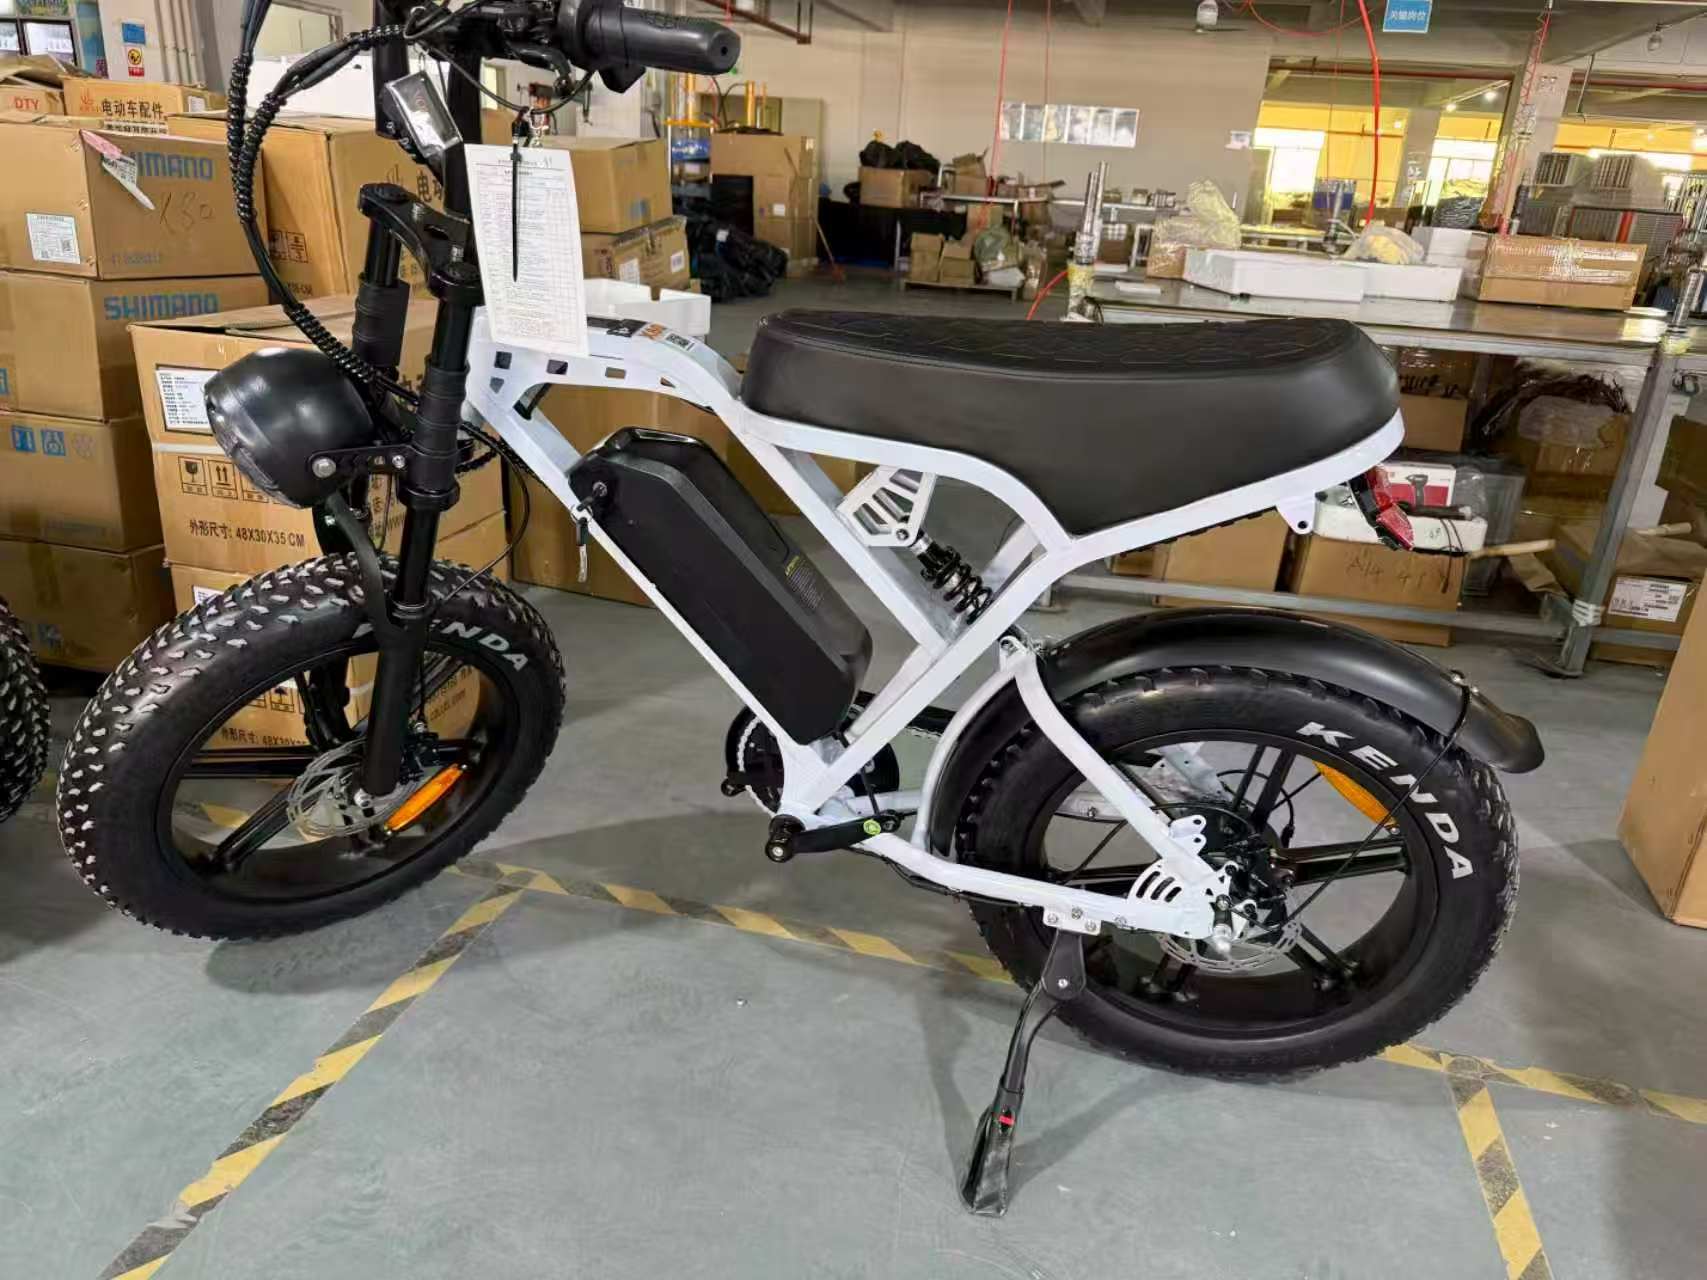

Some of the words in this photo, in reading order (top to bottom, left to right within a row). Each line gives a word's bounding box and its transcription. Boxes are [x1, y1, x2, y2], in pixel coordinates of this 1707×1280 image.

[102, 98, 164, 121] 电动车配件
[104, 293, 219, 320] SHIMANO
[236, 527, 287, 546] 48X30X35
[288, 532, 305, 547] CM
[1296, 721, 1474, 879] KENDA
